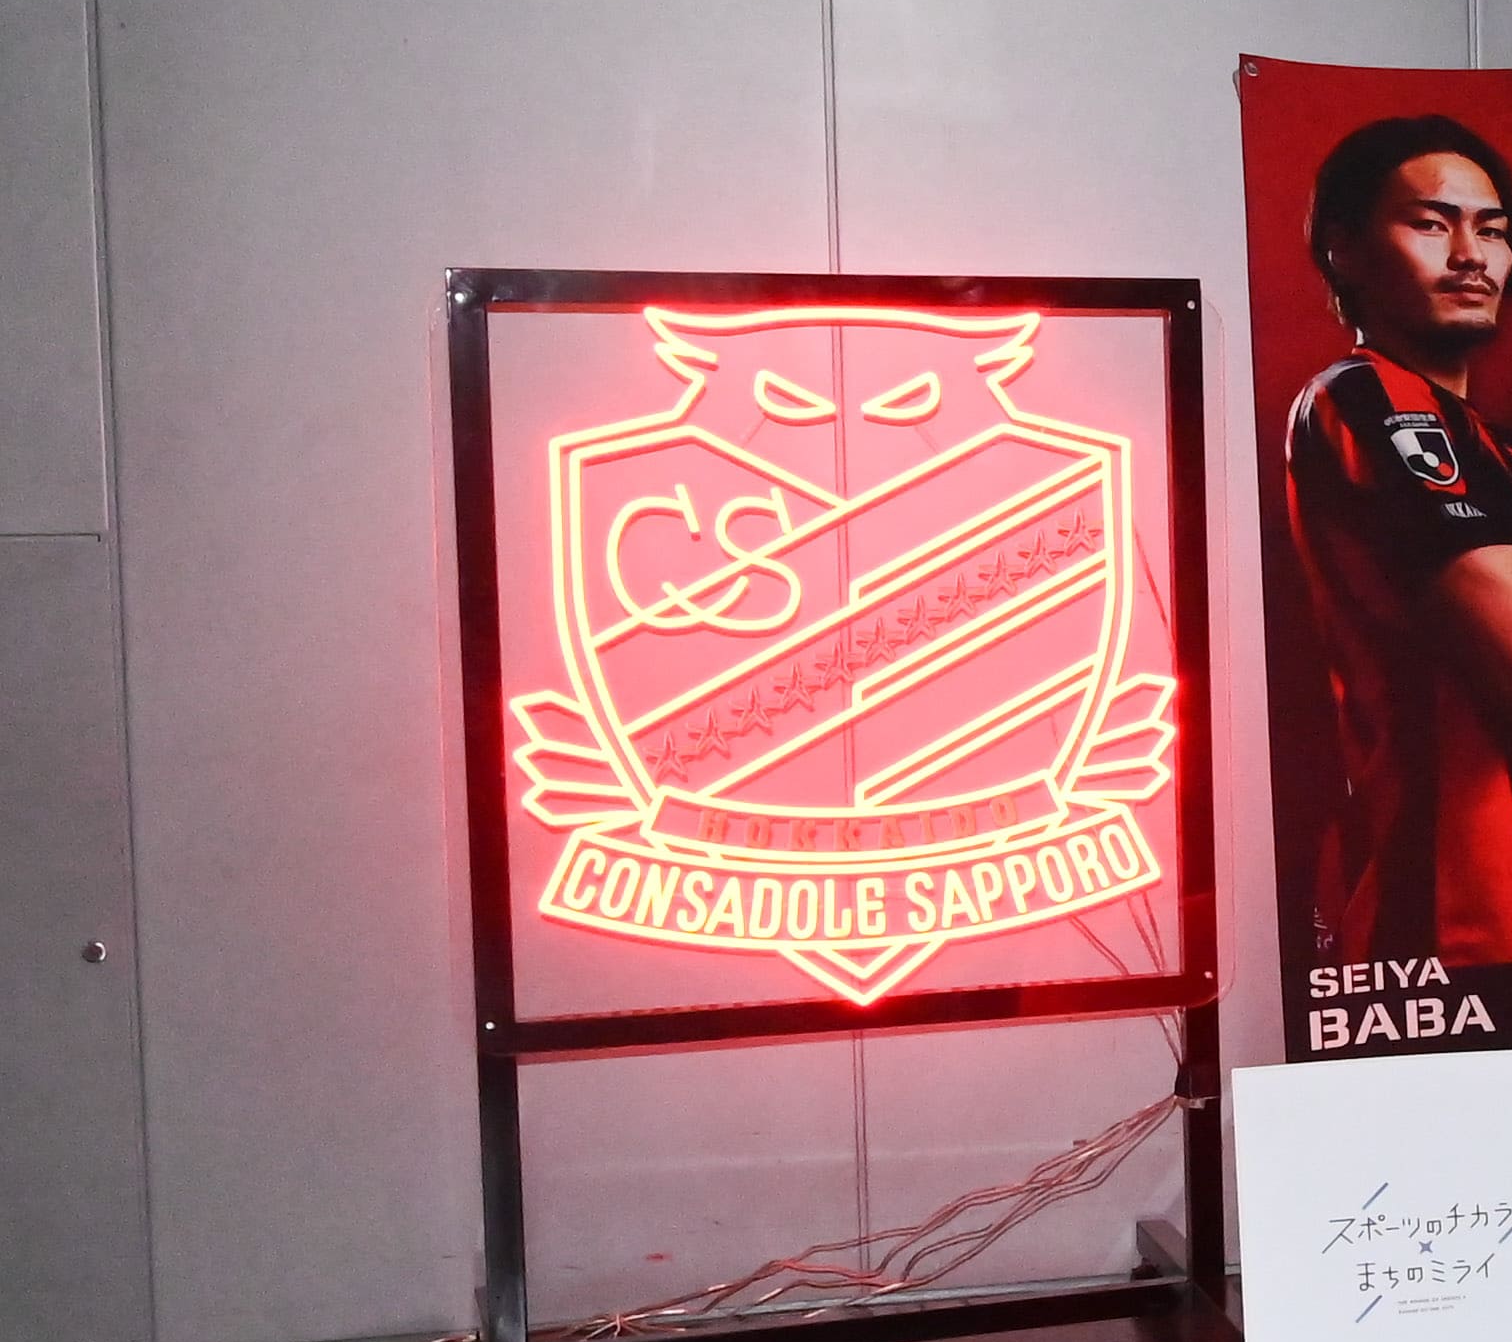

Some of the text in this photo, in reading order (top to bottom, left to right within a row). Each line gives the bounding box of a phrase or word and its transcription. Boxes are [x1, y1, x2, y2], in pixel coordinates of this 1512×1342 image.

[698, 795, 1018, 851] HOKKAIDO
[562, 822, 1141, 938] CONSADOLE SAPPORO
[1309, 956, 1451, 999] SEIYA
[1308, 994, 1497, 1051] BABA
[1322, 1202, 1512, 1255] スポーツのチカラ
[1356, 1253, 1496, 1292] まちのミライ
